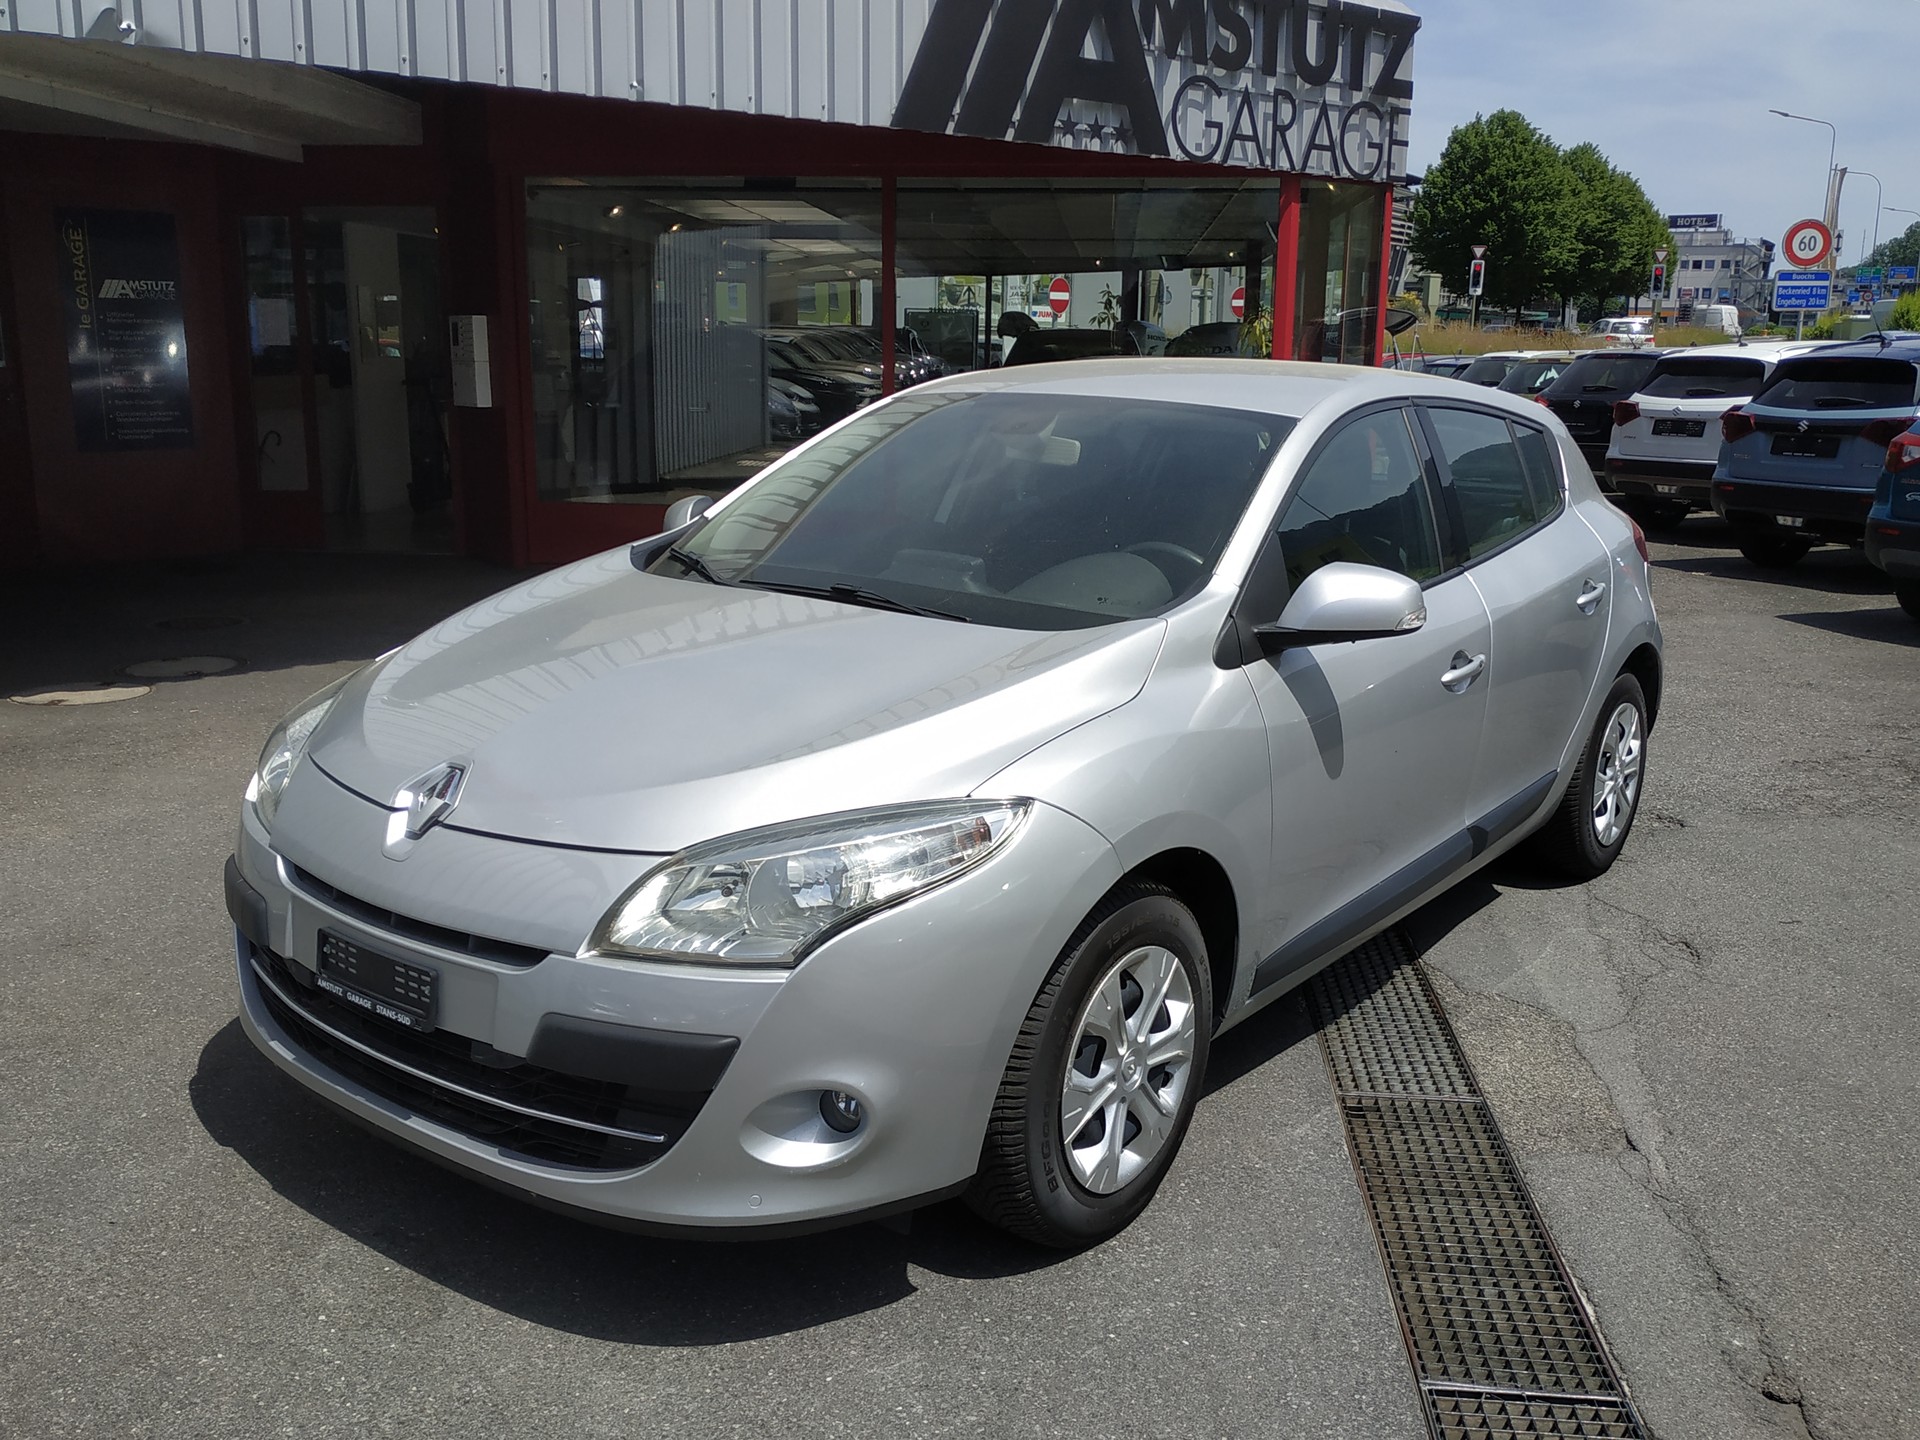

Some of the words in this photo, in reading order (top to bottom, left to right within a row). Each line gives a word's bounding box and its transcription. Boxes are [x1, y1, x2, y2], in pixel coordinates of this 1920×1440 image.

[1013, 0, 1422, 156] AMSTUTZ
[1171, 74, 1412, 182] GARAGE
[1676, 217, 1709, 226] HOTEL
[1798, 235, 1817, 252] 60
[69, 227, 90, 311] GARAGE
[113, 278, 176, 299] AMSTUTZ
[134, 290, 176, 301] GARAGE
[1778, 287, 1811, 295] Beckenried
[1817, 287, 1827, 295] km
[1777, 297, 1807, 308] Engelberg
[1808, 298, 1816, 306] 20
[1816, 298, 1826, 306] km
[317, 978, 343, 997] AMSTUTZ
[346, 992, 372, 1009] GARAGE
[376, 1004, 411, 1026] STANS-SÜD
